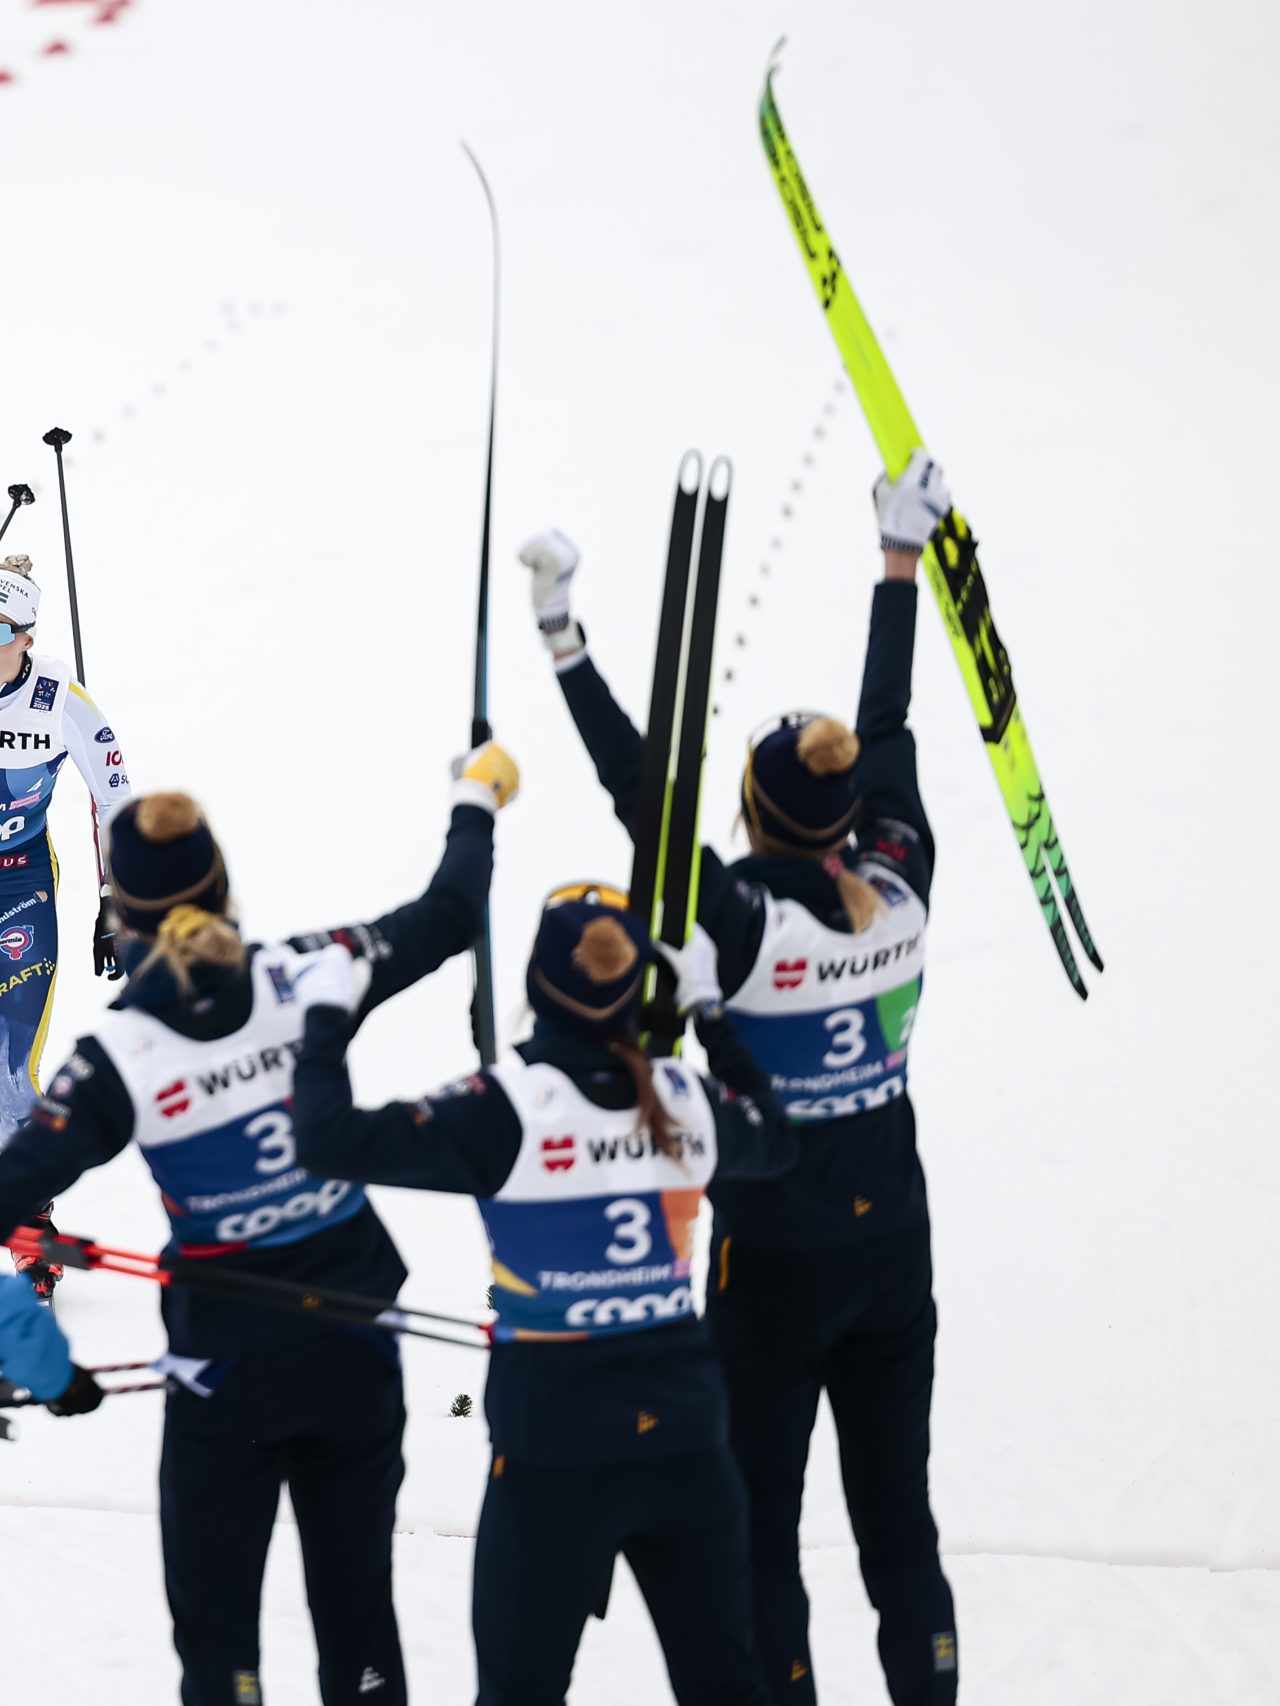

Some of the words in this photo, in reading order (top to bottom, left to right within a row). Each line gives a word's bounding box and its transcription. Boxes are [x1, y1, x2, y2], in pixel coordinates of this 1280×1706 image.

[817, 933, 922, 983] WÜRTH
[822, 1007, 867, 1068] 3
[242, 1110, 298, 1173] 3
[604, 1198, 652, 1265] 3
